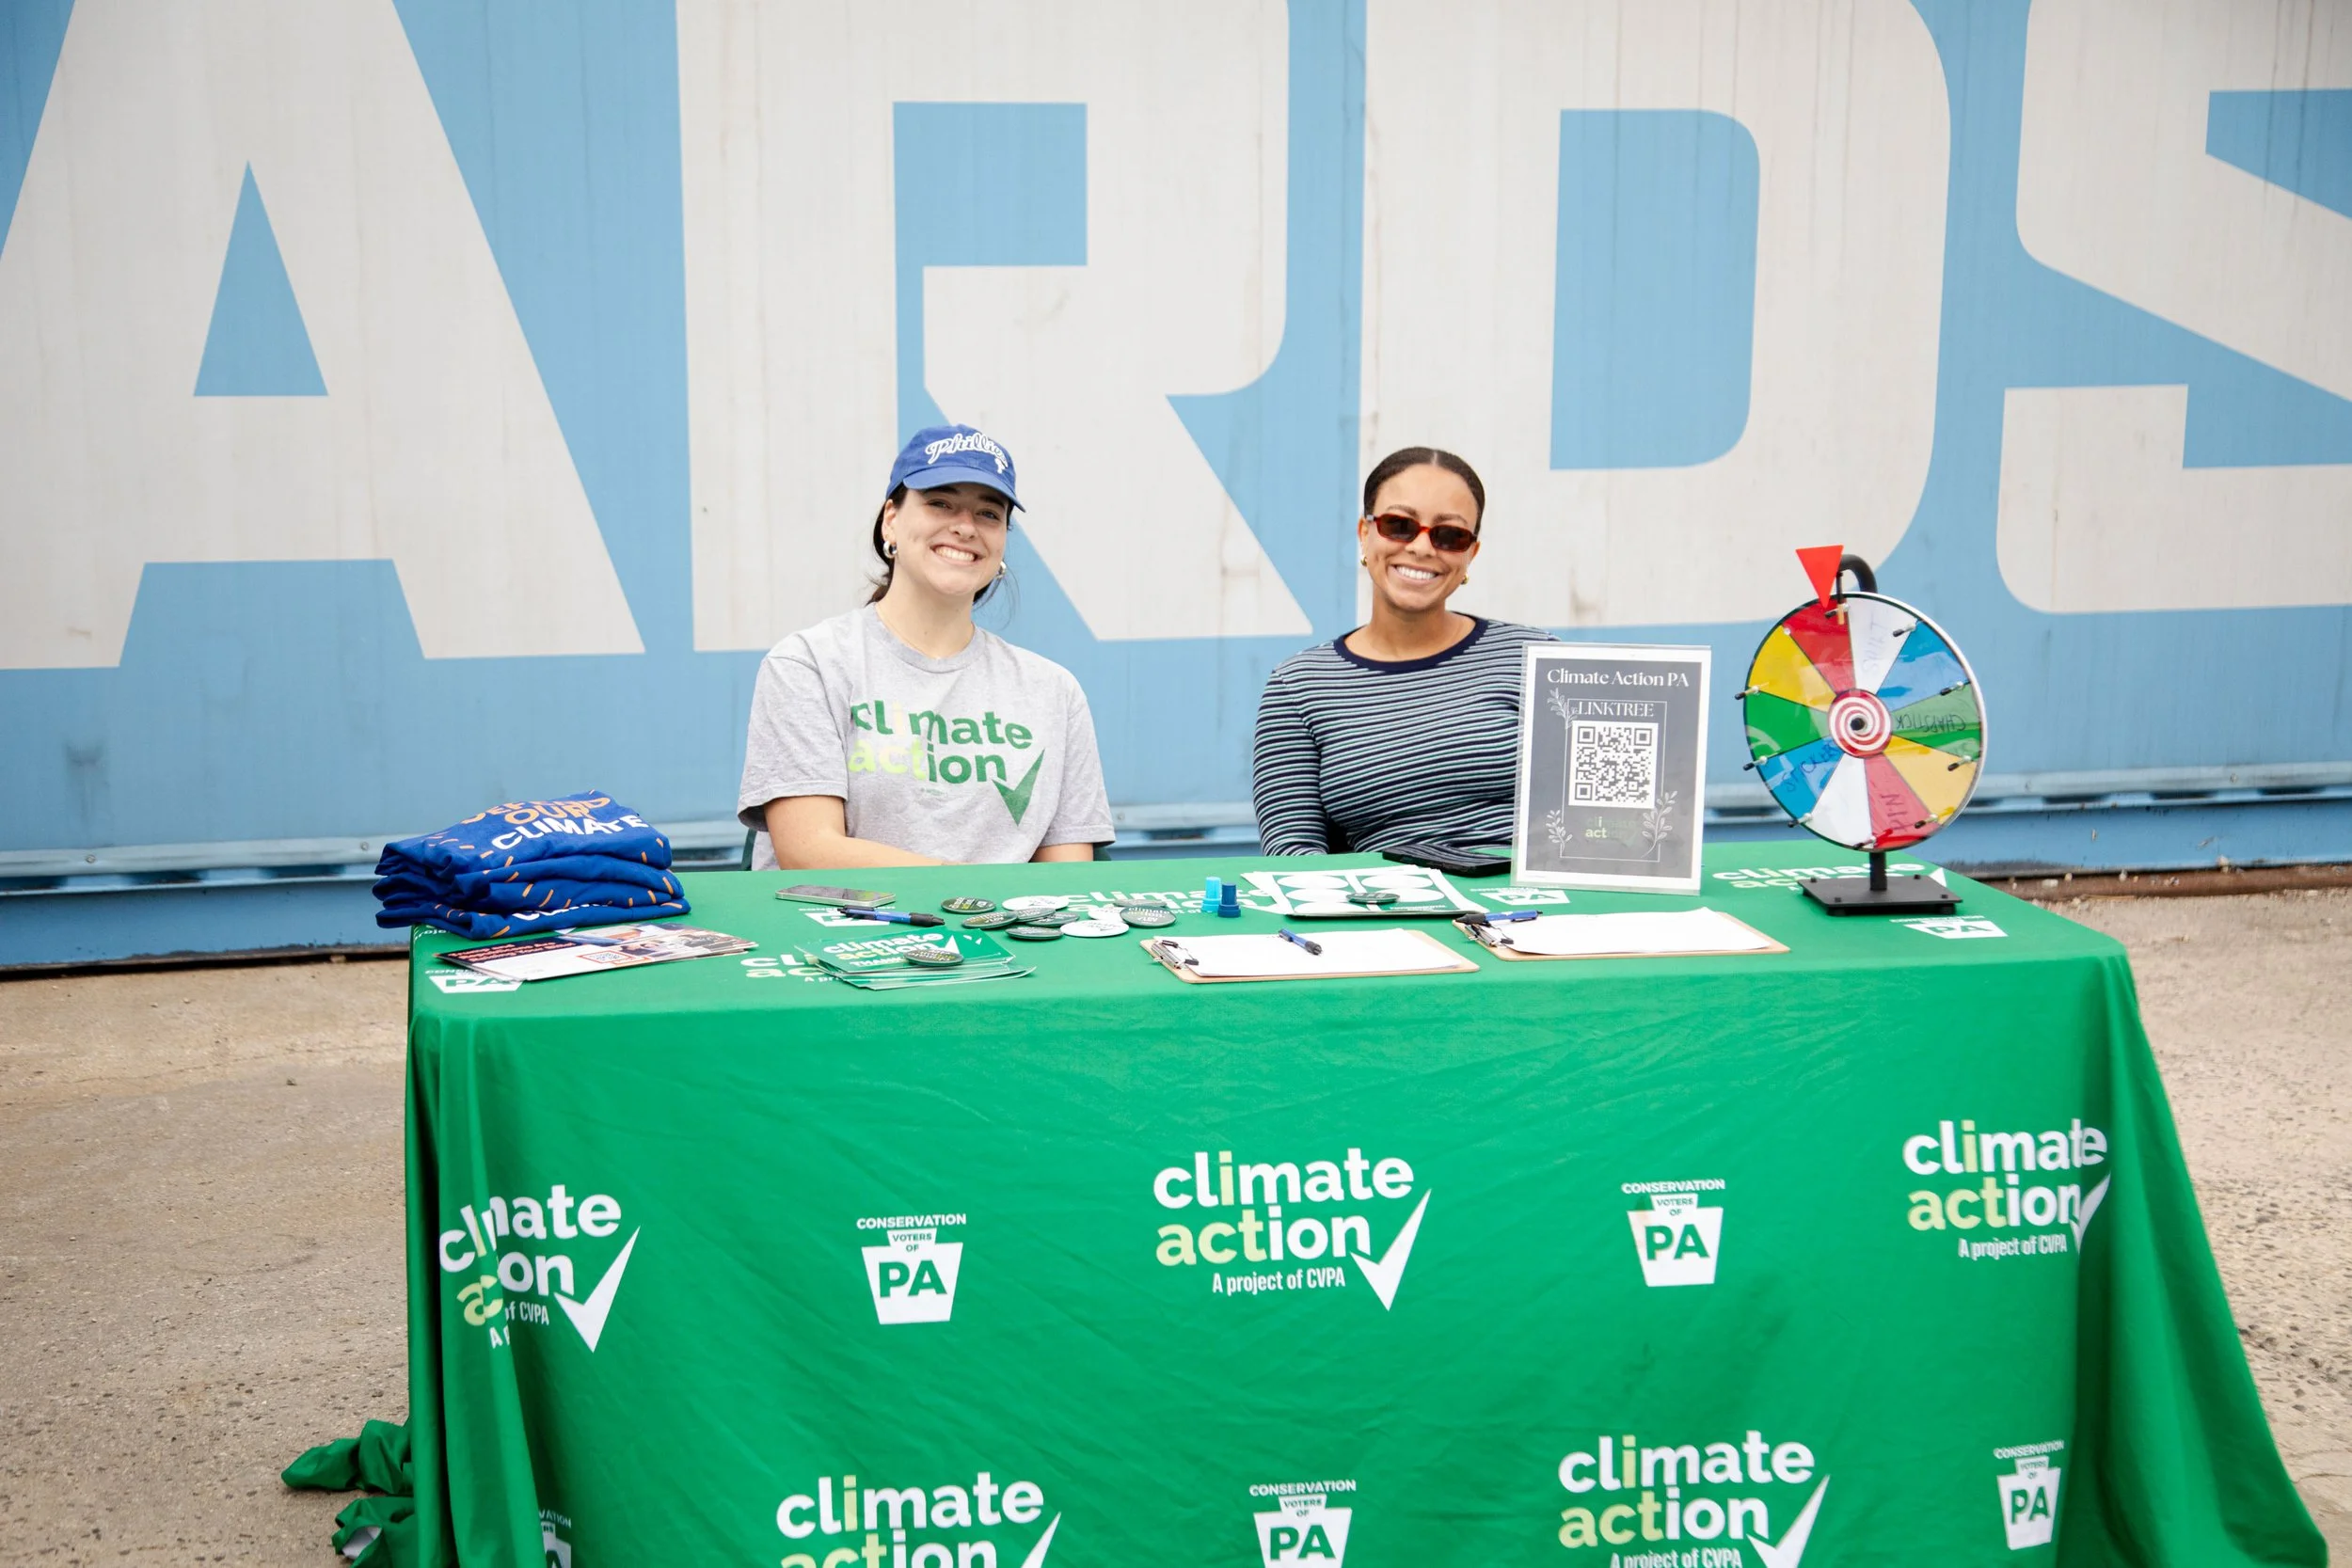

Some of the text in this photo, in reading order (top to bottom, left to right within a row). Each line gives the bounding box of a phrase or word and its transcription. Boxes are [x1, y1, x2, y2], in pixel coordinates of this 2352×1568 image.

[1547, 668, 1690, 687] Climate Action PA
[1578, 701, 1655, 717] LINKTREE
[850, 700, 1033, 750] climate
[848, 738, 1008, 784] action
[491, 815, 650, 850] CLIMATE
[1925, 923, 1992, 933] PA
[823, 932, 945, 954] climate
[835, 942, 938, 960] action
[1902, 1117, 2108, 1175] climate
[1153, 1148, 1415, 1209] climate
[1621, 1179, 1725, 1195] CONSERVATION
[1656, 1197, 1694, 1207] VOTERS
[1907, 1173, 2081, 1231] action
[856, 1213, 967, 1229] CONSERVATION
[892, 1233, 932, 1242] VOTERS
[905, 1244, 920, 1253] OF
[1155, 1205, 1372, 1266] action
[1645, 1224, 1710, 1261] PA
[1958, 1233, 2068, 1260] A project of CVPA
[879, 1259, 947, 1298] PA
[1213, 1266, 1345, 1296] A project of CVPA
[519, 1302, 549, 1326] CVPA
[1558, 1430, 1816, 1494] climate
[1993, 1439, 2065, 1459] CONSERVATION
[1249, 1479, 1357, 1497] CONSERVATION
[776, 1471, 1044, 1539] climate
[1283, 1498, 1322, 1508] VOTERS
[2010, 1485, 2051, 1525] PA
[1558, 1486, 1770, 1549] action
[1270, 1524, 1336, 1561] PA
[1624, 1550, 1678, 1568] project
[1681, 1548, 1699, 1568] of
[1701, 1547, 1743, 1568] CVPA
